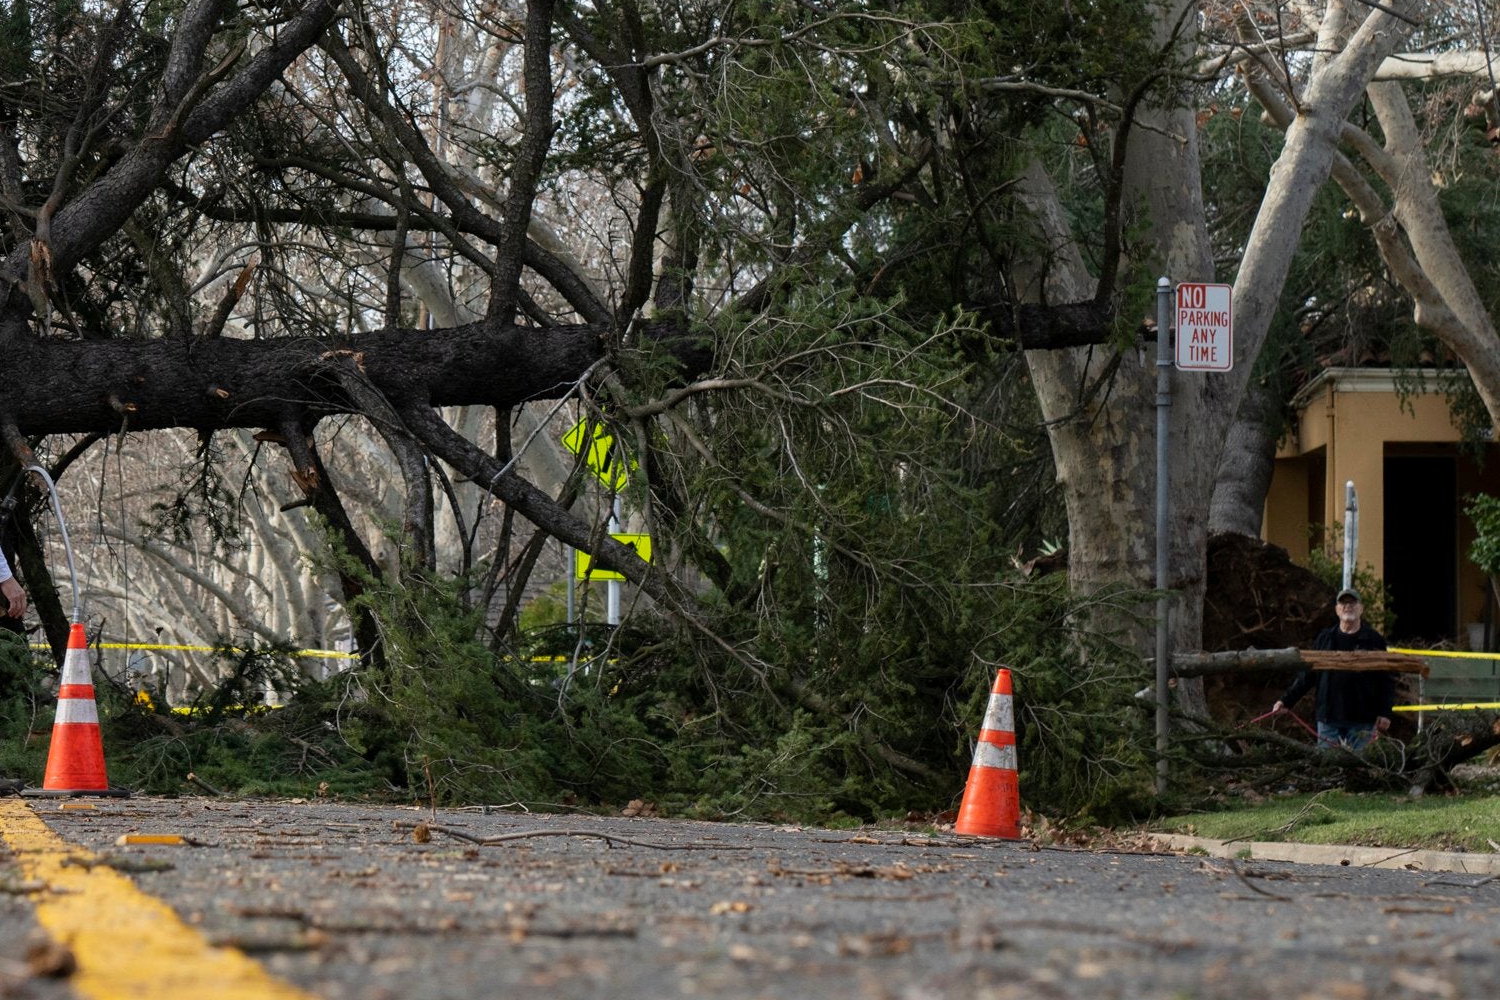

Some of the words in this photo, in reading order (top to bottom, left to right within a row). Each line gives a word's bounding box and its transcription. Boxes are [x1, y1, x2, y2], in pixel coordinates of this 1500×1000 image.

[1182, 287, 1203, 307] NO
[1181, 310, 1228, 327] PARKING
[1191, 329, 1216, 344] ANY
[1189, 346, 1217, 362] TIME
